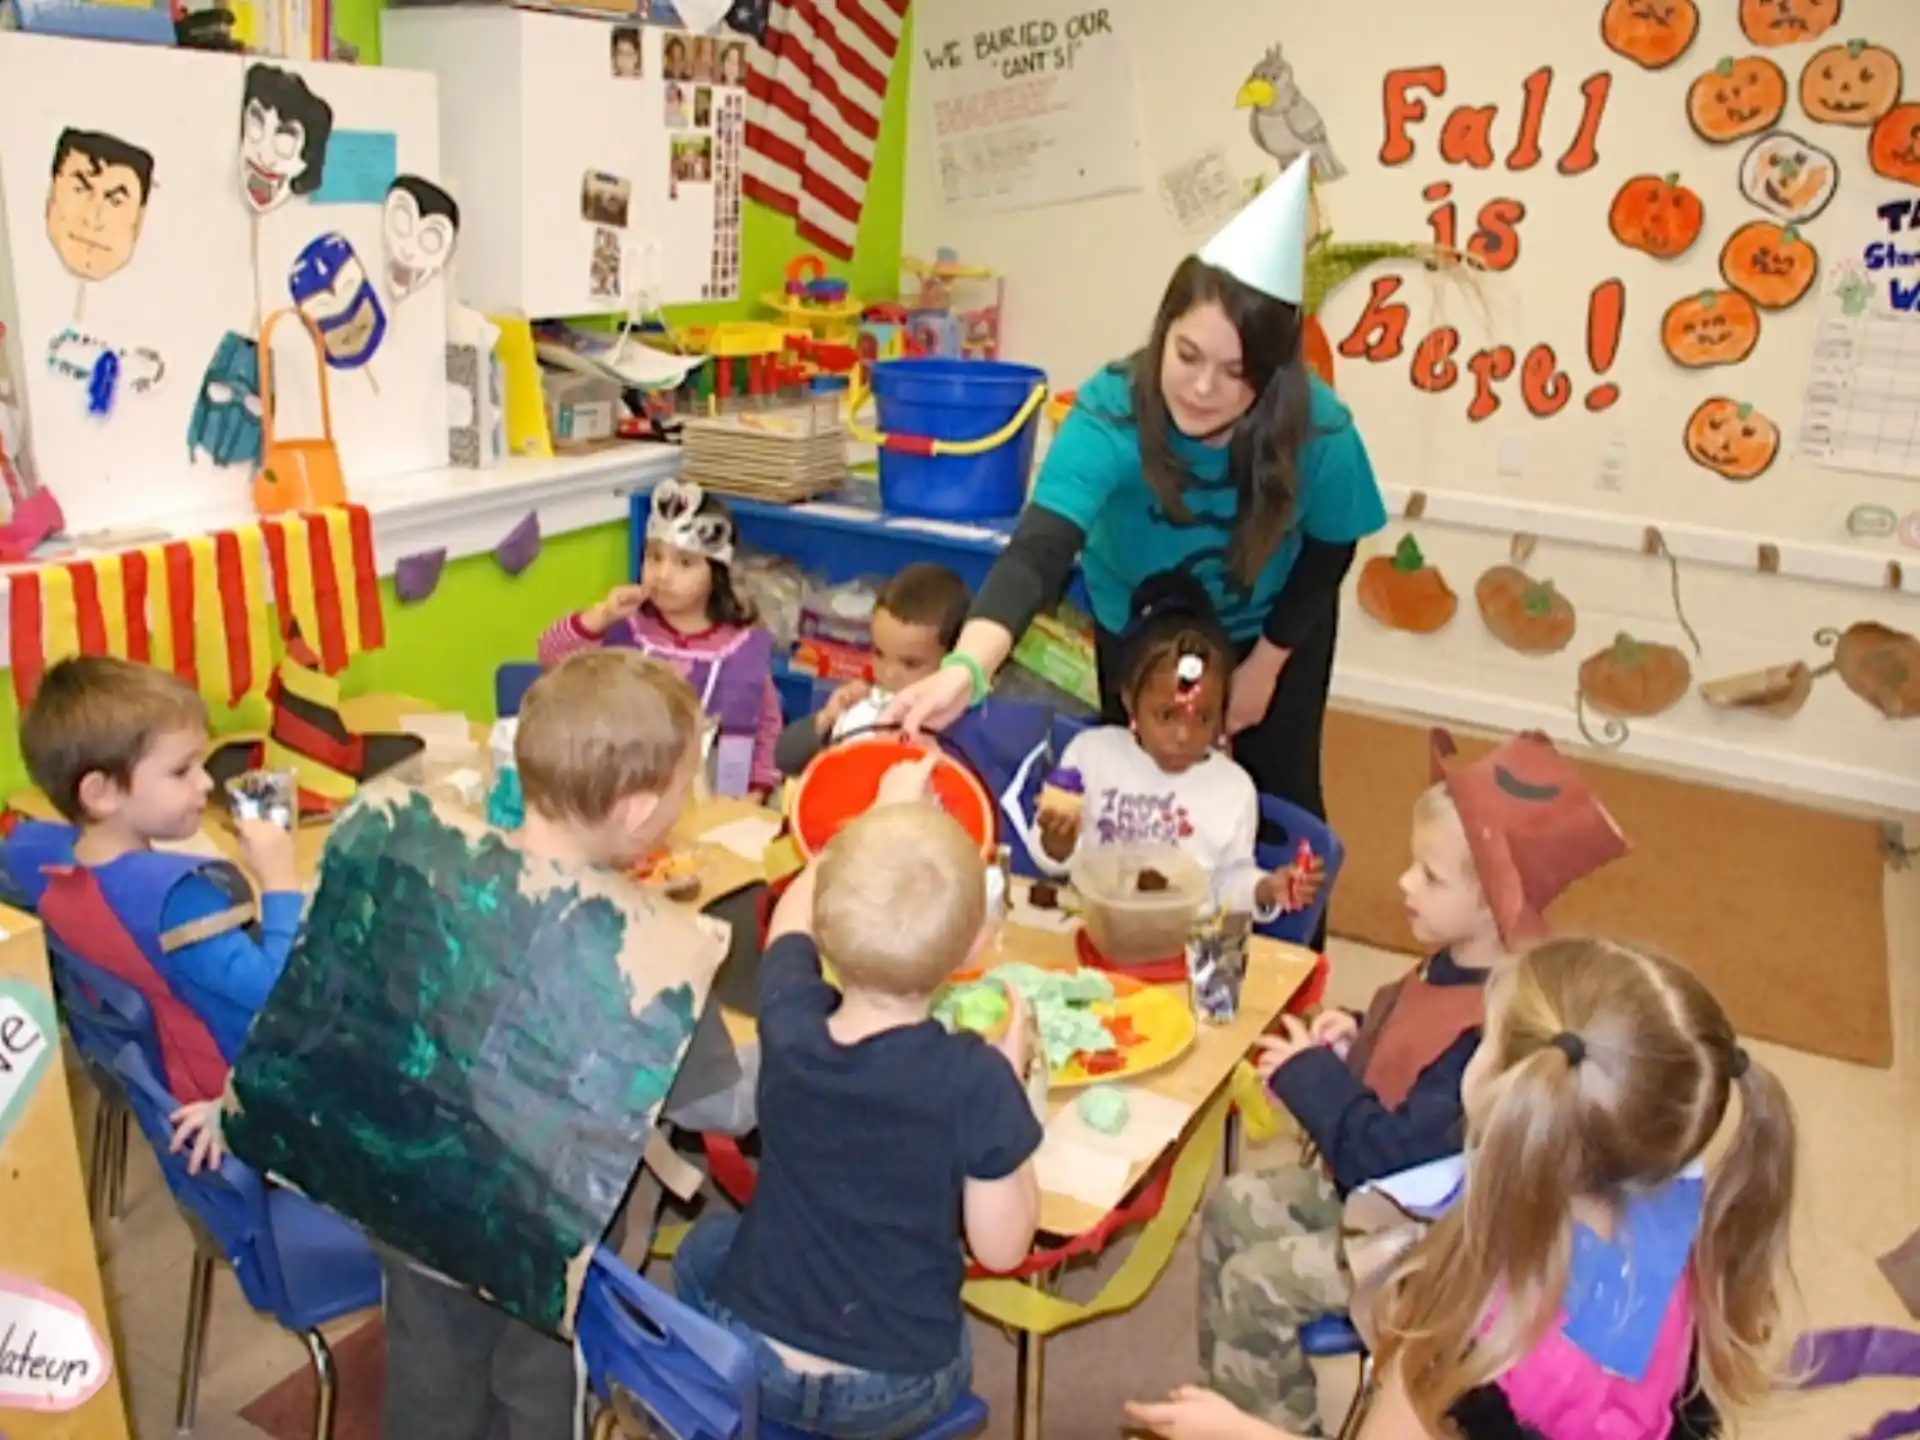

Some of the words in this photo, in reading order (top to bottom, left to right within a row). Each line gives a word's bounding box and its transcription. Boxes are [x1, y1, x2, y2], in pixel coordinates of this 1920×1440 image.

[925, 41, 963, 70] WE
[973, 20, 1058, 60] BURIED
[1065, 8, 1112, 40] OUR
[1378, 64, 1612, 176] Fall
[1421, 180, 1526, 272] is
[1337, 275, 1626, 423] here!
